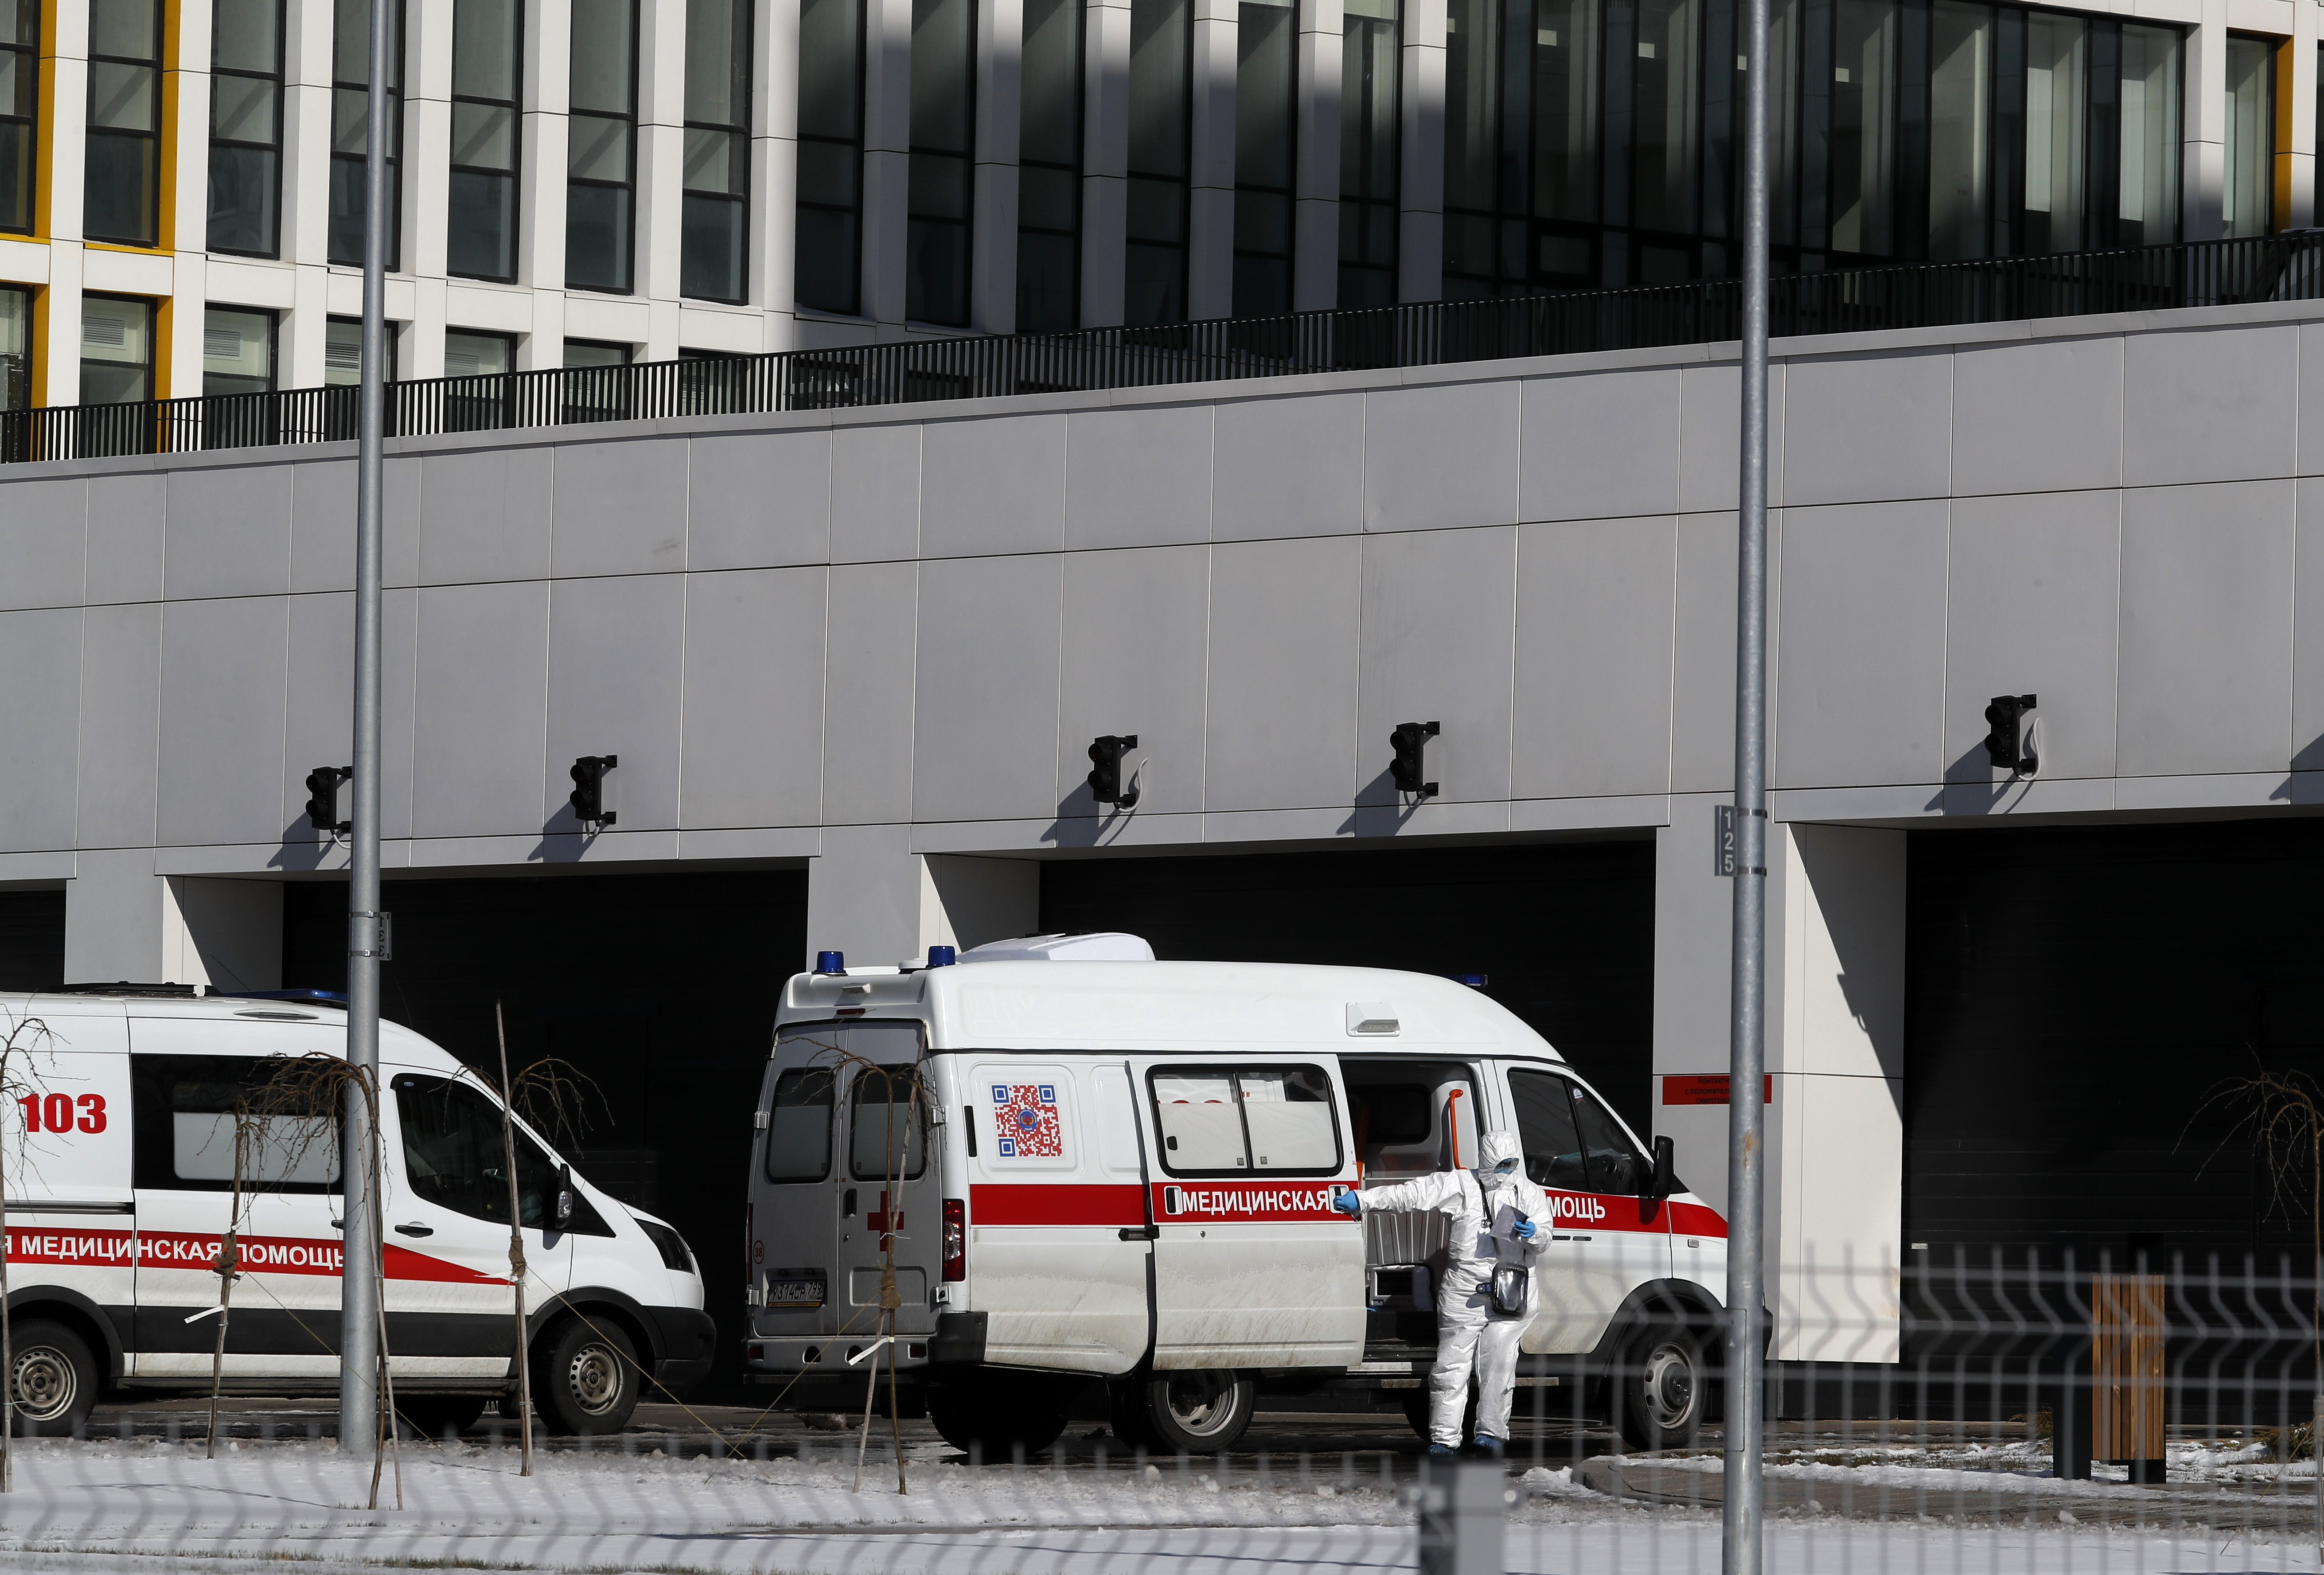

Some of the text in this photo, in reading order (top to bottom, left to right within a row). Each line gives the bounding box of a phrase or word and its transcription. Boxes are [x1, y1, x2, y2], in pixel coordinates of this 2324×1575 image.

[1725, 811, 1733, 872] 125
[17, 1093, 107, 1134] 103
[1182, 1190, 1606, 1223] МЕДИЦИНСКАЯ МОЩЬ
[22, 1235, 222, 1261] МЕДИЦИНСКАЯ
[754, 1247, 763, 1258] 38
